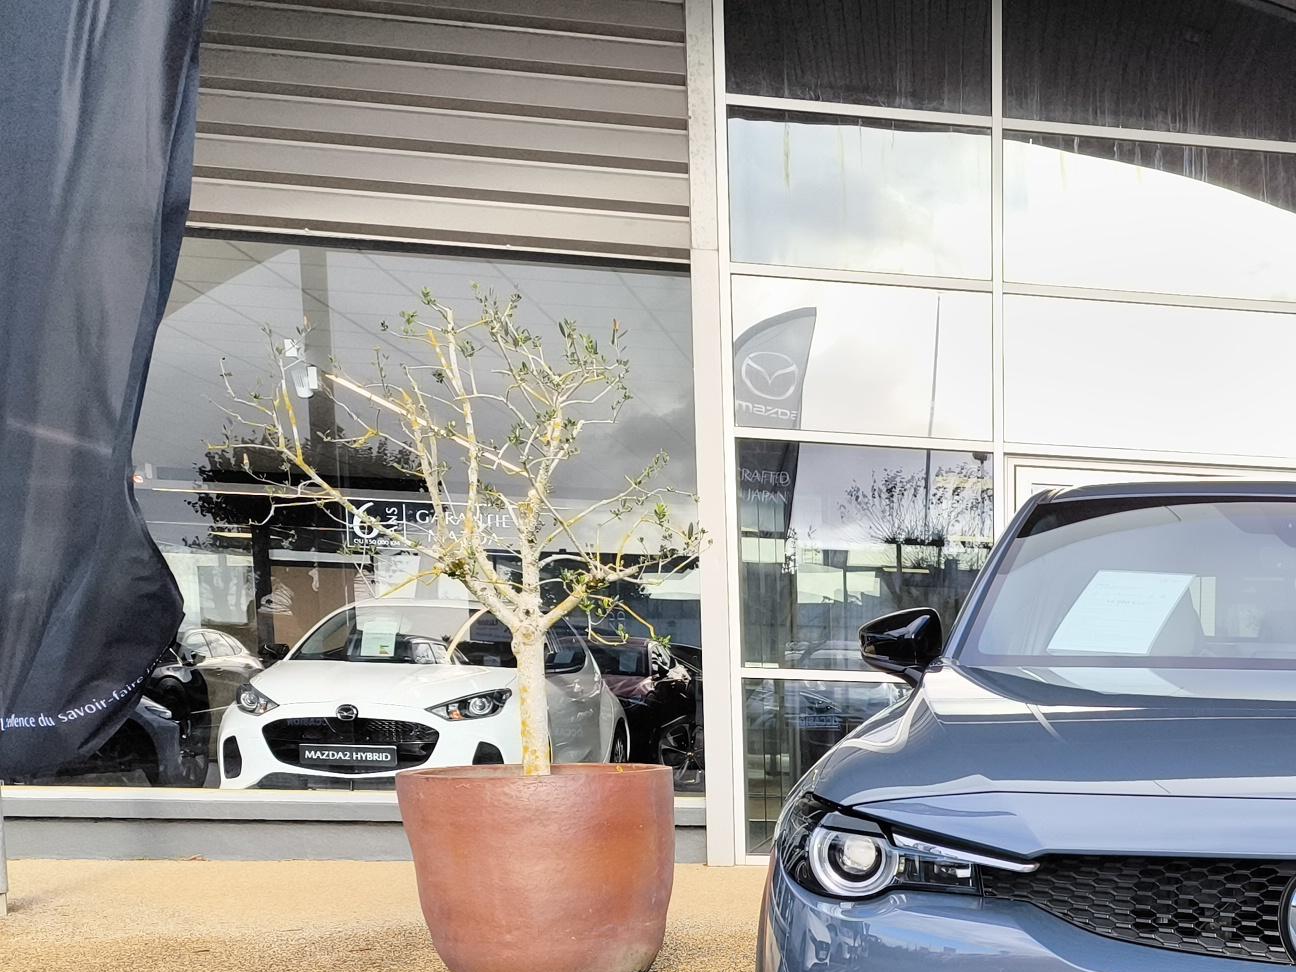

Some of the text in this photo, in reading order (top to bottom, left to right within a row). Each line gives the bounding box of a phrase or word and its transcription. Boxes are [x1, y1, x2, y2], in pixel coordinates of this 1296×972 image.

[353, 501, 379, 539] 6
[38, 713, 56, 727] du
[304, 750, 391, 761] MAZDA2 HYBRID
